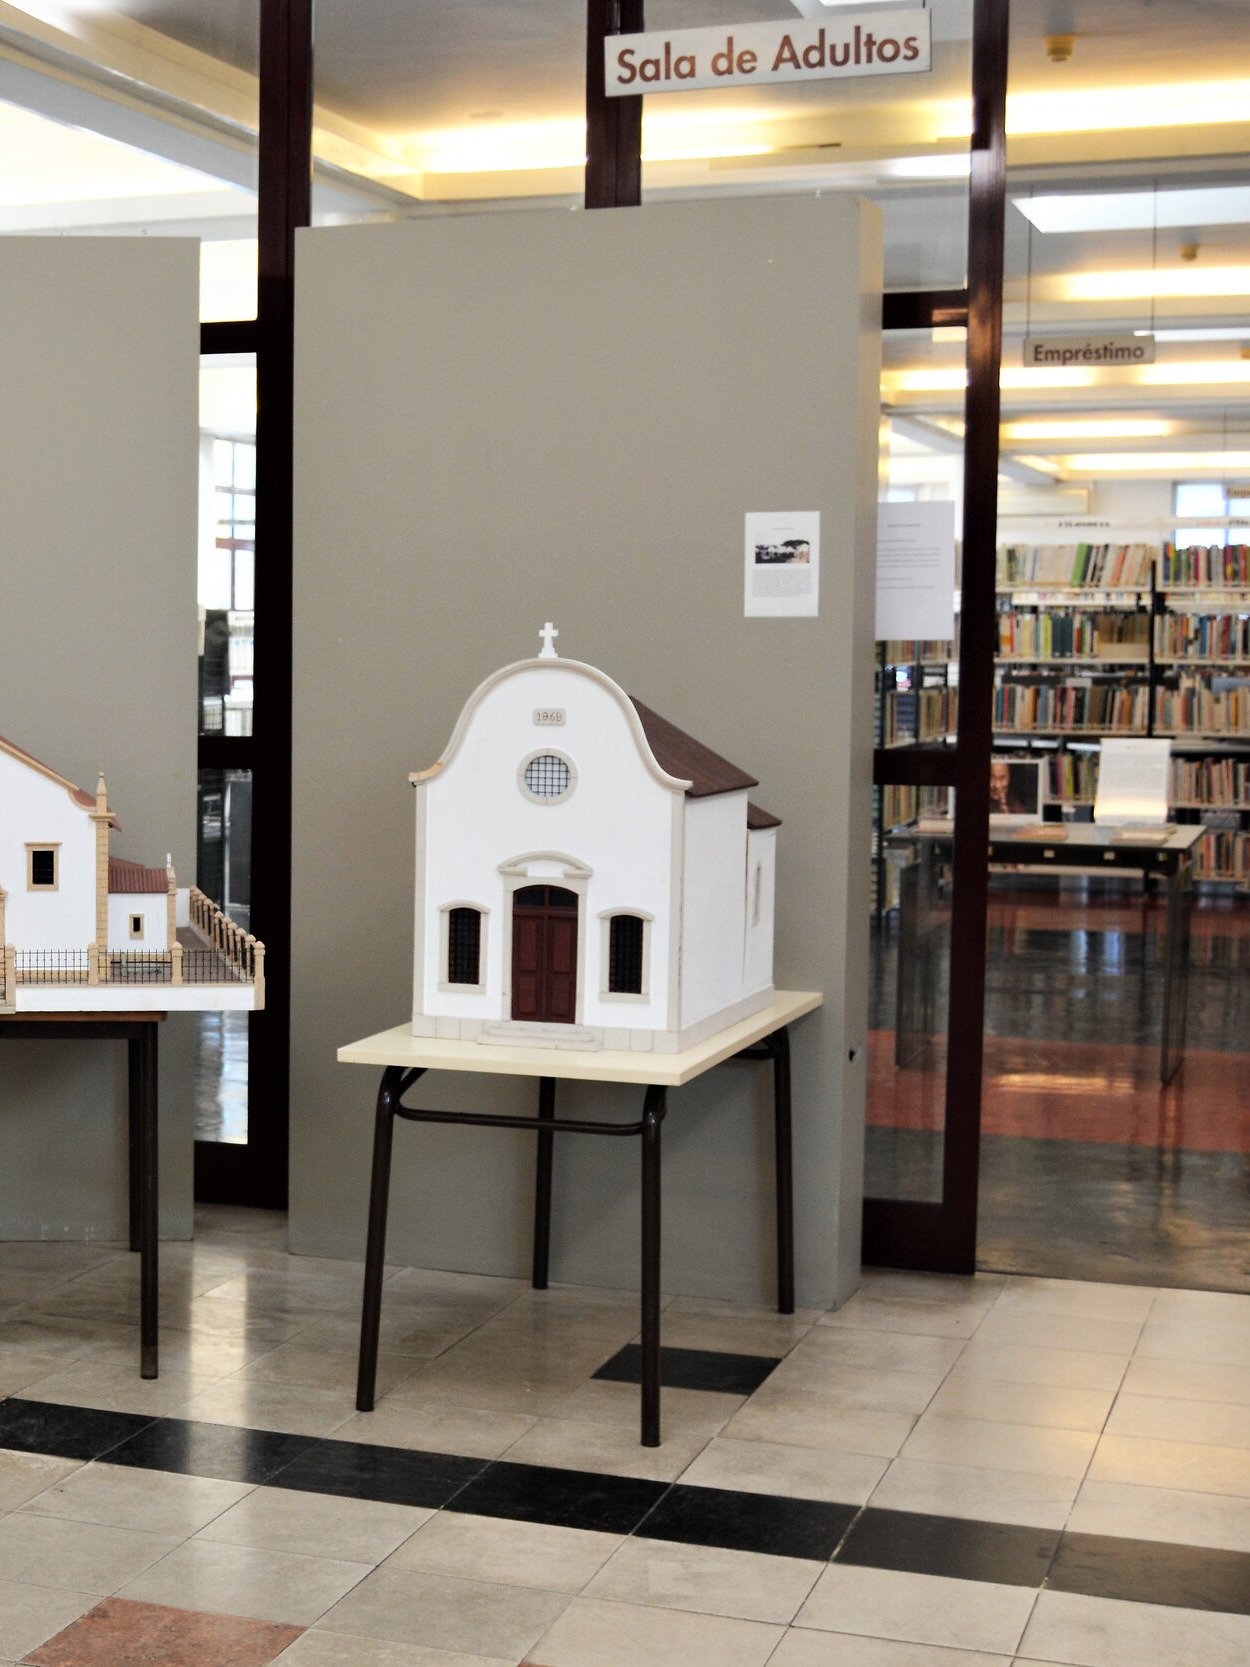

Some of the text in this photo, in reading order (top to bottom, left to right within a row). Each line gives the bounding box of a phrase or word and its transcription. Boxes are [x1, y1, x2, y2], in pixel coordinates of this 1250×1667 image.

[617, 25, 920, 84] Sala de Adultos
[1033, 342, 1145, 366] Empréstimo
